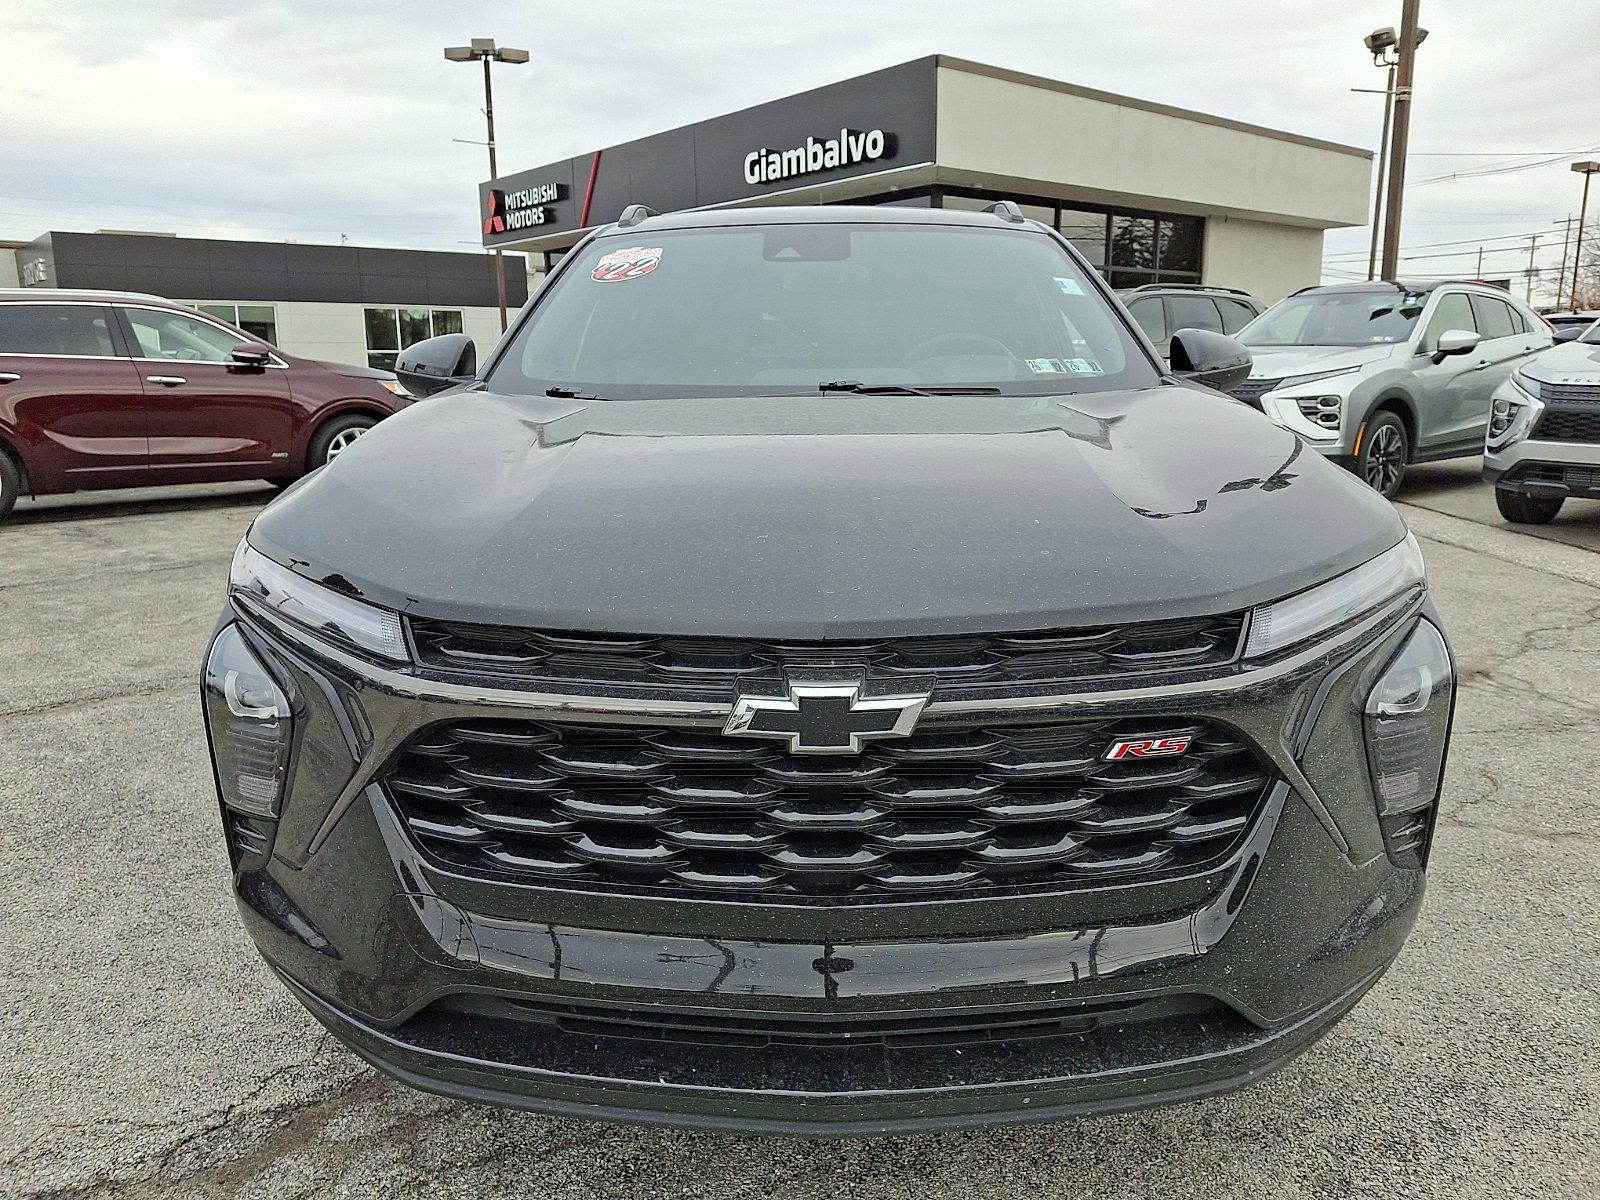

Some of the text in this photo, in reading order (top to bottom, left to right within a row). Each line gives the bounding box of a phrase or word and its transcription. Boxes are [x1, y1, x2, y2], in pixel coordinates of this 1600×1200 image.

[744, 127, 884, 184] Giambalvo
[504, 182, 558, 211] MITSUBISHI
[506, 206, 545, 230] MOTORS
[1105, 736, 1191, 759] RS
